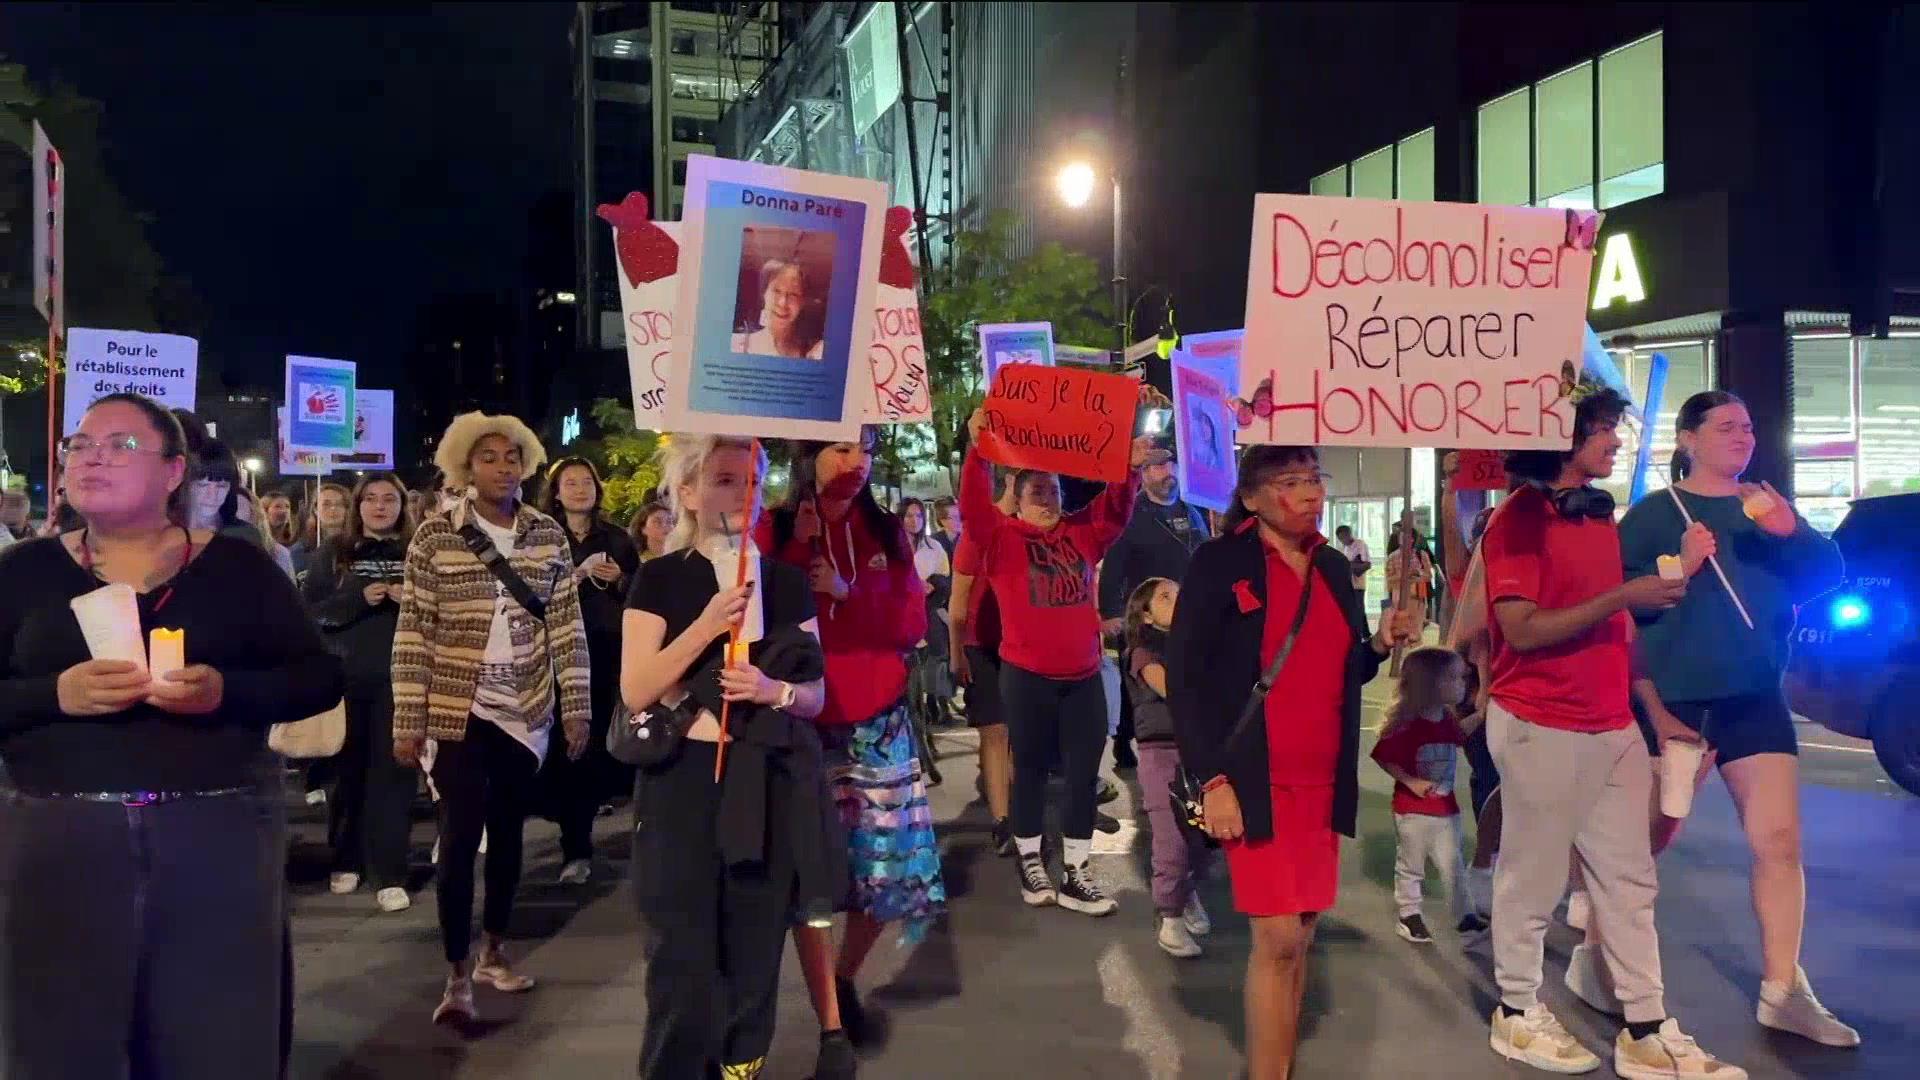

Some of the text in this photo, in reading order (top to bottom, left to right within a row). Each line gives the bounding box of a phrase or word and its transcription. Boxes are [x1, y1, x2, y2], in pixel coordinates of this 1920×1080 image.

[742, 188, 799, 212] Donna
[1327, 295, 1535, 377] Réparer
[106, 341, 158, 358] Pour le
[75, 360, 185, 378] rétablissement
[94, 379, 167, 396] des droits
[1268, 369, 1573, 445] HONORER
